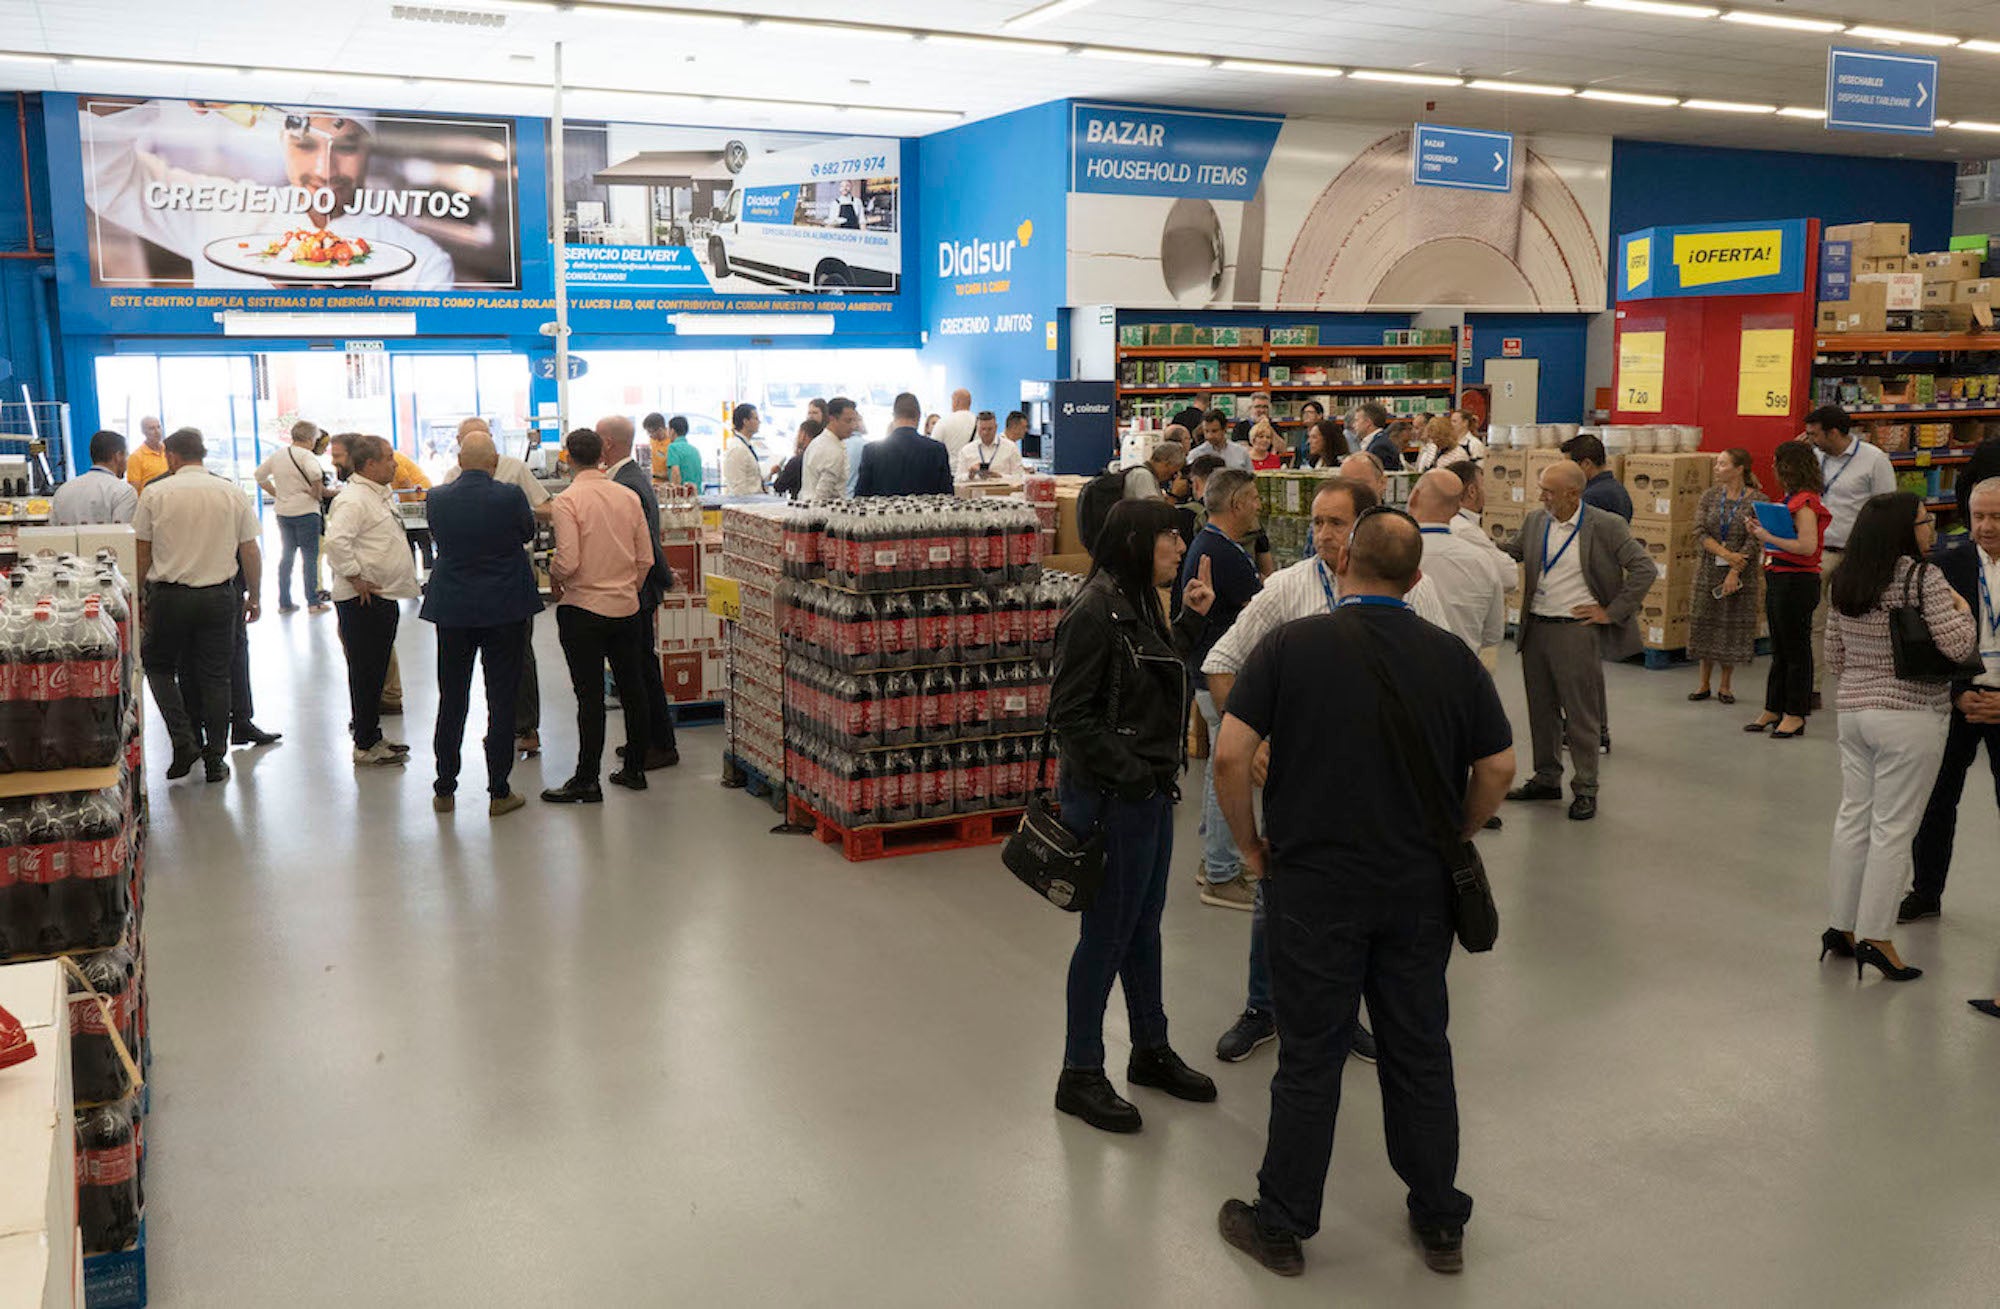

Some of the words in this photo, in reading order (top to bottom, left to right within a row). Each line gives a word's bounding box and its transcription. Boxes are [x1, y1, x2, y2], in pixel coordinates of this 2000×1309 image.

[1087, 119, 1165, 147] BAZAR
[1423, 139, 1445, 148] BAZAR
[822, 161, 839, 175] 682
[842, 159, 860, 174] 779
[863, 156, 886, 172] 974
[1423, 154, 1458, 165] HOUSEHOLD
[1086, 158, 1191, 183] HOUSEHOLD
[1197, 164, 1248, 186] ITEMS
[145, 180, 336, 214] CRECIENDO
[343, 186, 473, 218] JUNTOS
[746, 194, 781, 206] Dialsur
[564, 248, 620, 261] SERVICIO
[621, 249, 680, 262] DELIVERY
[939, 238, 1016, 278] Dialsur
[1688, 247, 1771, 264] ¡OFERTA!
[110, 296, 141, 307] ESTE
[144, 296, 194, 307] CENTRO
[196, 296, 244, 307] EMPLEA
[247, 297, 307, 307] SISTEMAS
[309, 297, 324, 307] DE
[327, 295, 375, 307] ENERGÍA
[378, 297, 440, 308] EFICIENTES
[442, 297, 475, 308] COMO
[477, 298, 519, 309] PLACAS
[570, 299, 578, 309] Y
[579, 299, 612, 309] LUCES
[635, 299, 656, 310] QUE
[657, 299, 724, 311] CONTRIBUYEN
[725, 300, 733, 310] A
[735, 300, 770, 311] CUIDAR
[772, 301, 814, 311] NUESTRO
[817, 301, 846, 311] MEDIO
[847, 302, 893, 312] AMBIENTE
[940, 316, 990, 335] CRECIENDO
[993, 313, 1033, 333] JUNTOS
[544, 363, 555, 378] 2
[571, 363, 578, 377] 1
[1076, 402, 1110, 413] coinstar
